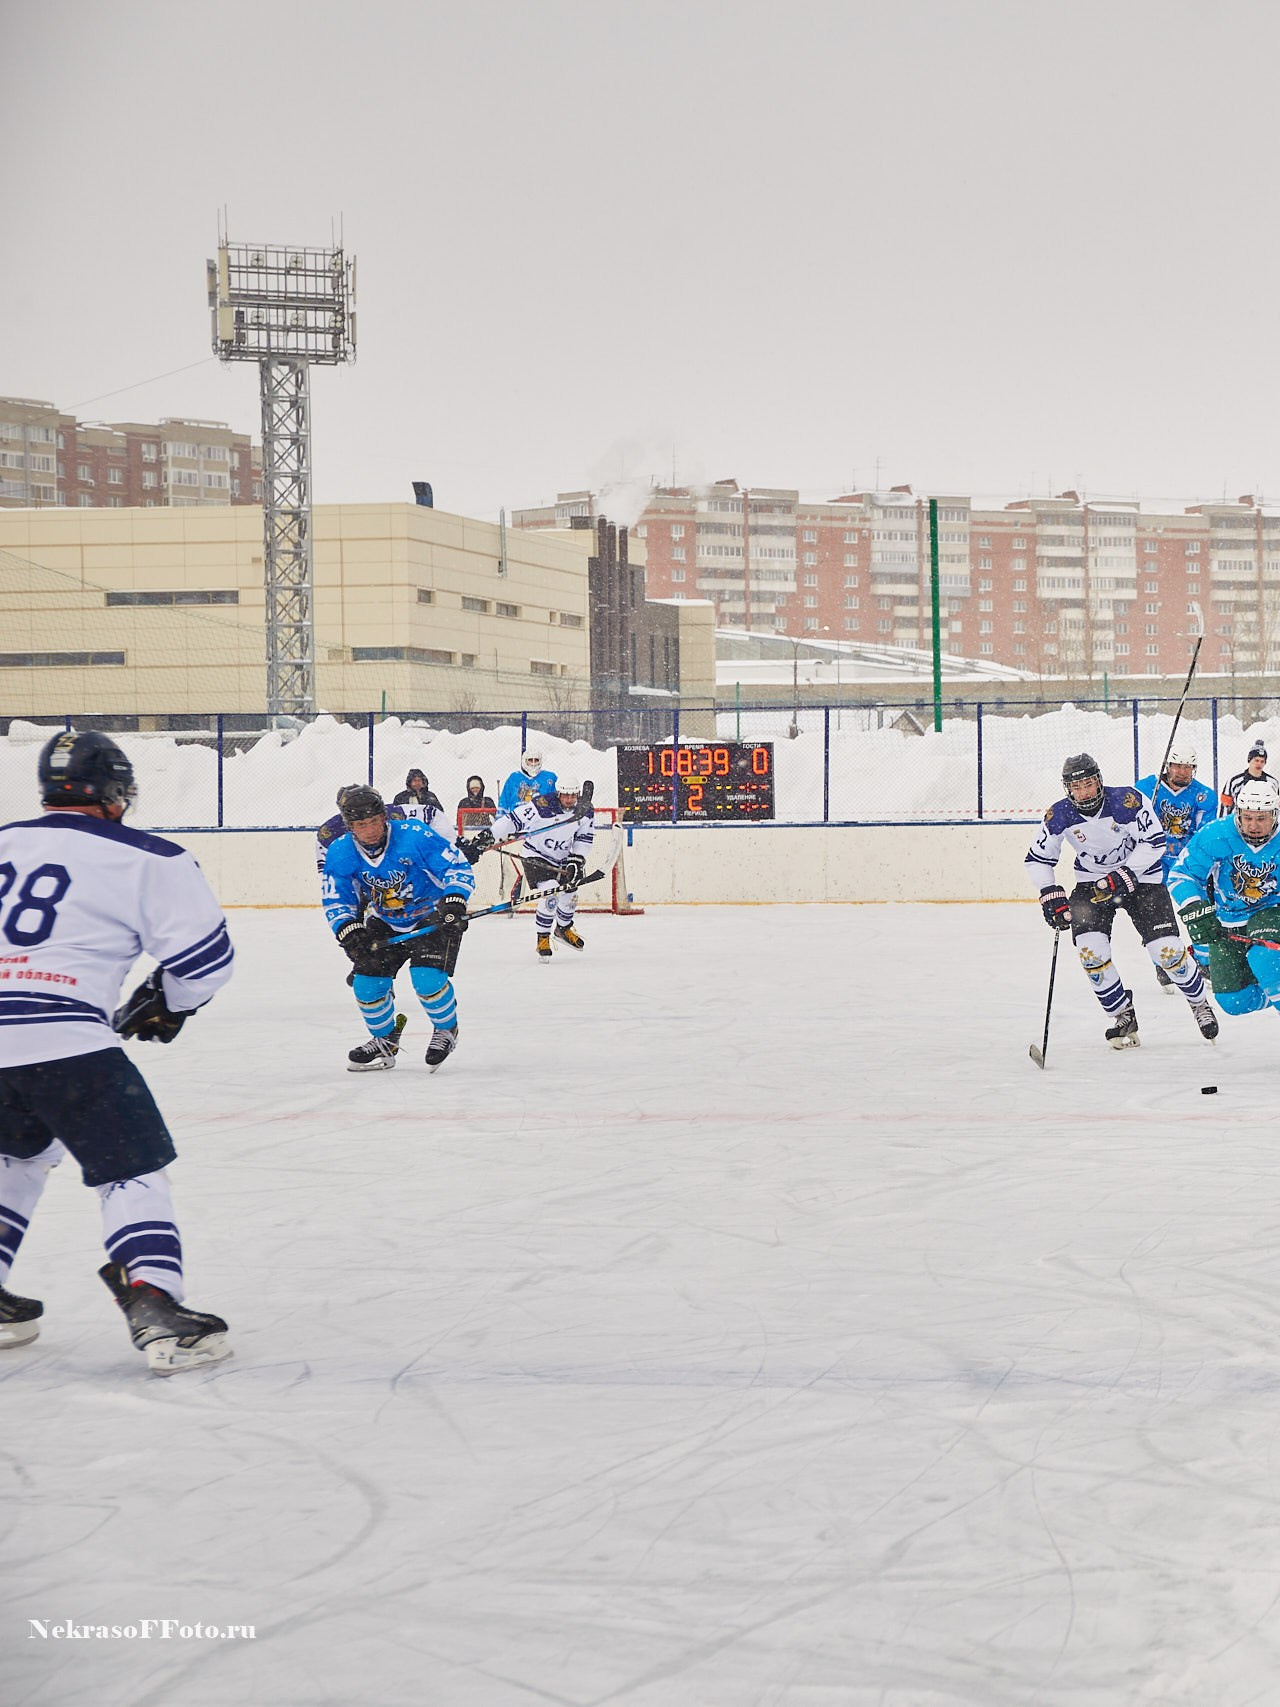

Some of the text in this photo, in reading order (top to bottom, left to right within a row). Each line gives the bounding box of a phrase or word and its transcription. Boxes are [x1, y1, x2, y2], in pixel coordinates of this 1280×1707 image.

[752, 748, 769, 775] 0
[687, 784, 704, 811] 2
[523, 807, 536, 821] 41
[1136, 810, 1153, 832] 42
[17, 968, 77, 987] области
